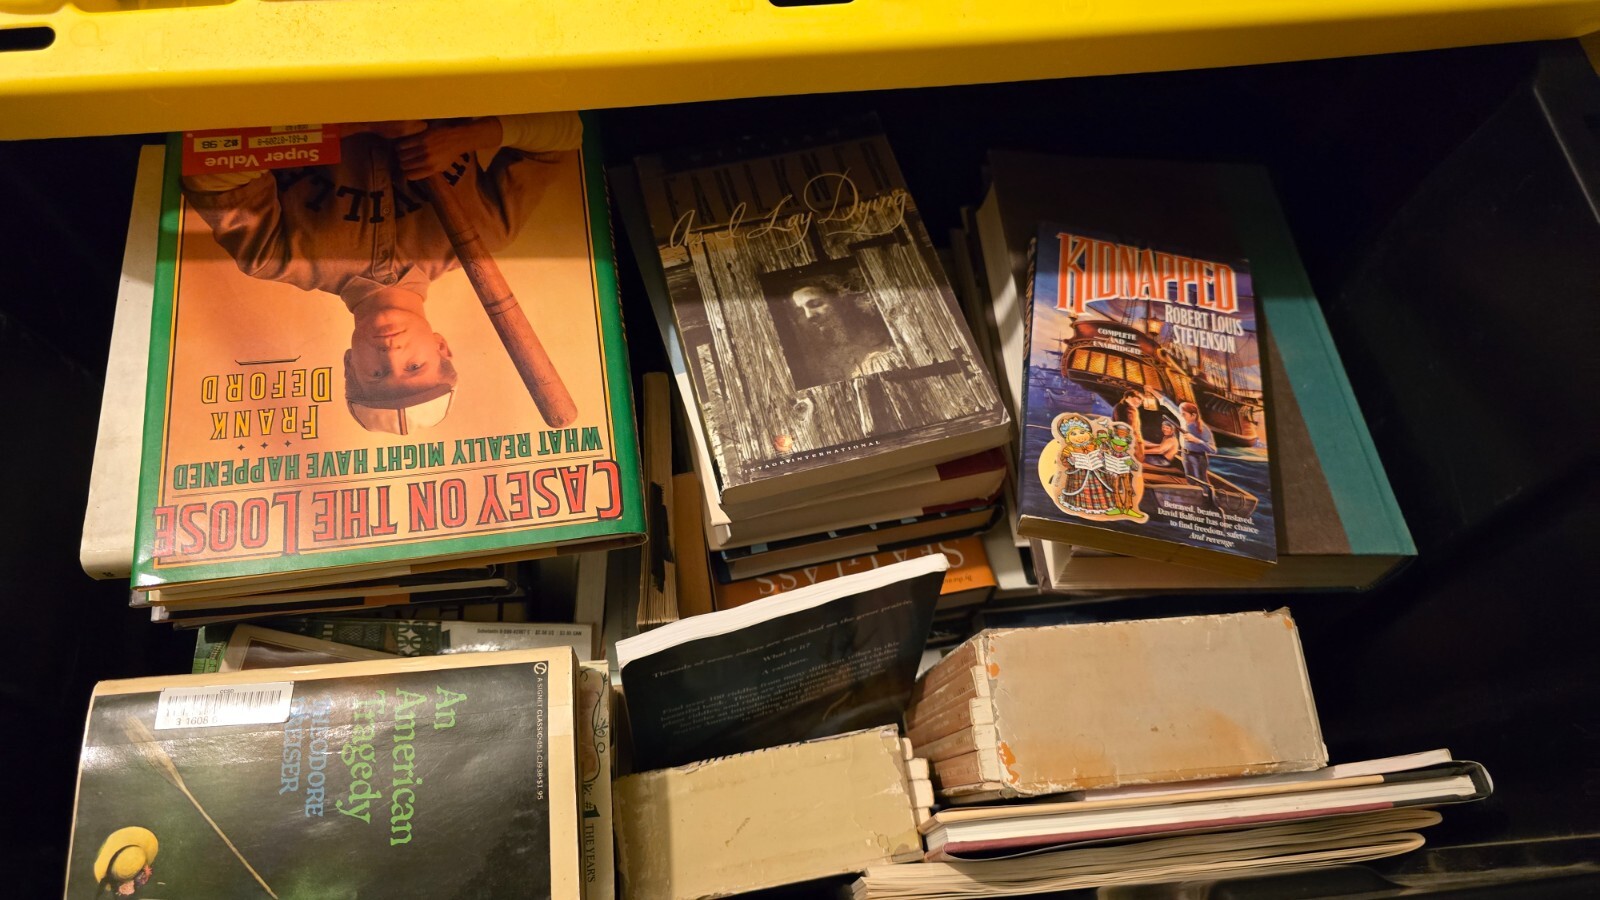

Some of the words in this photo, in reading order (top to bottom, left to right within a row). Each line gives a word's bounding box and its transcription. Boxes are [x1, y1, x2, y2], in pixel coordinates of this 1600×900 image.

[204, 154, 260, 169] Value
[264, 148, 319, 163] Super
[669, 209, 705, 249] As
[746, 194, 813, 250] Lay
[803, 167, 907, 237] Dying
[1054, 232, 1239, 316] KIDNAPPED
[1097, 327, 1137, 341] COMPLETE
[1165, 304, 1209, 327] ROBERT
[1211, 314, 1245, 336] LOUIS
[1092, 340, 1142, 355] UNABRIDGED
[1107, 336, 1125, 345] AND
[1172, 325, 1236, 354] STEVENSON
[201, 367, 332, 404] DEFORD
[210, 405, 319, 440] FRANK
[373, 441, 445, 472] MIGHT
[452, 432, 532, 466] REALLY
[537, 426, 604, 456] WHAT
[737, 460, 785, 475] VINTAGE
[790, 440, 881, 463] INTERNATIONAL
[173, 454, 300, 490] HAPPENED
[306, 448, 368, 479] HAVE
[407, 478, 468, 533] ON
[476, 459, 624, 526] CASEY
[152, 490, 301, 557] LOOSE
[312, 485, 398, 542] THE
[1157, 507, 1178, 517] David
[1179, 511, 1205, 523] Balfour
[1206, 517, 1218, 526] has
[1219, 521, 1232, 529] one
[1234, 523, 1260, 534] chance
[1169, 519, 1178, 527] to
[1178, 520, 1193, 530] find
[1189, 532, 1205, 540] And
[175, 717, 181, 726] 3
[433, 684, 468, 730] An
[305, 694, 332, 818] THEODORE
[335, 689, 386, 824] Tragedy
[390, 687, 428, 846] American
[585, 823, 595, 846] THE
